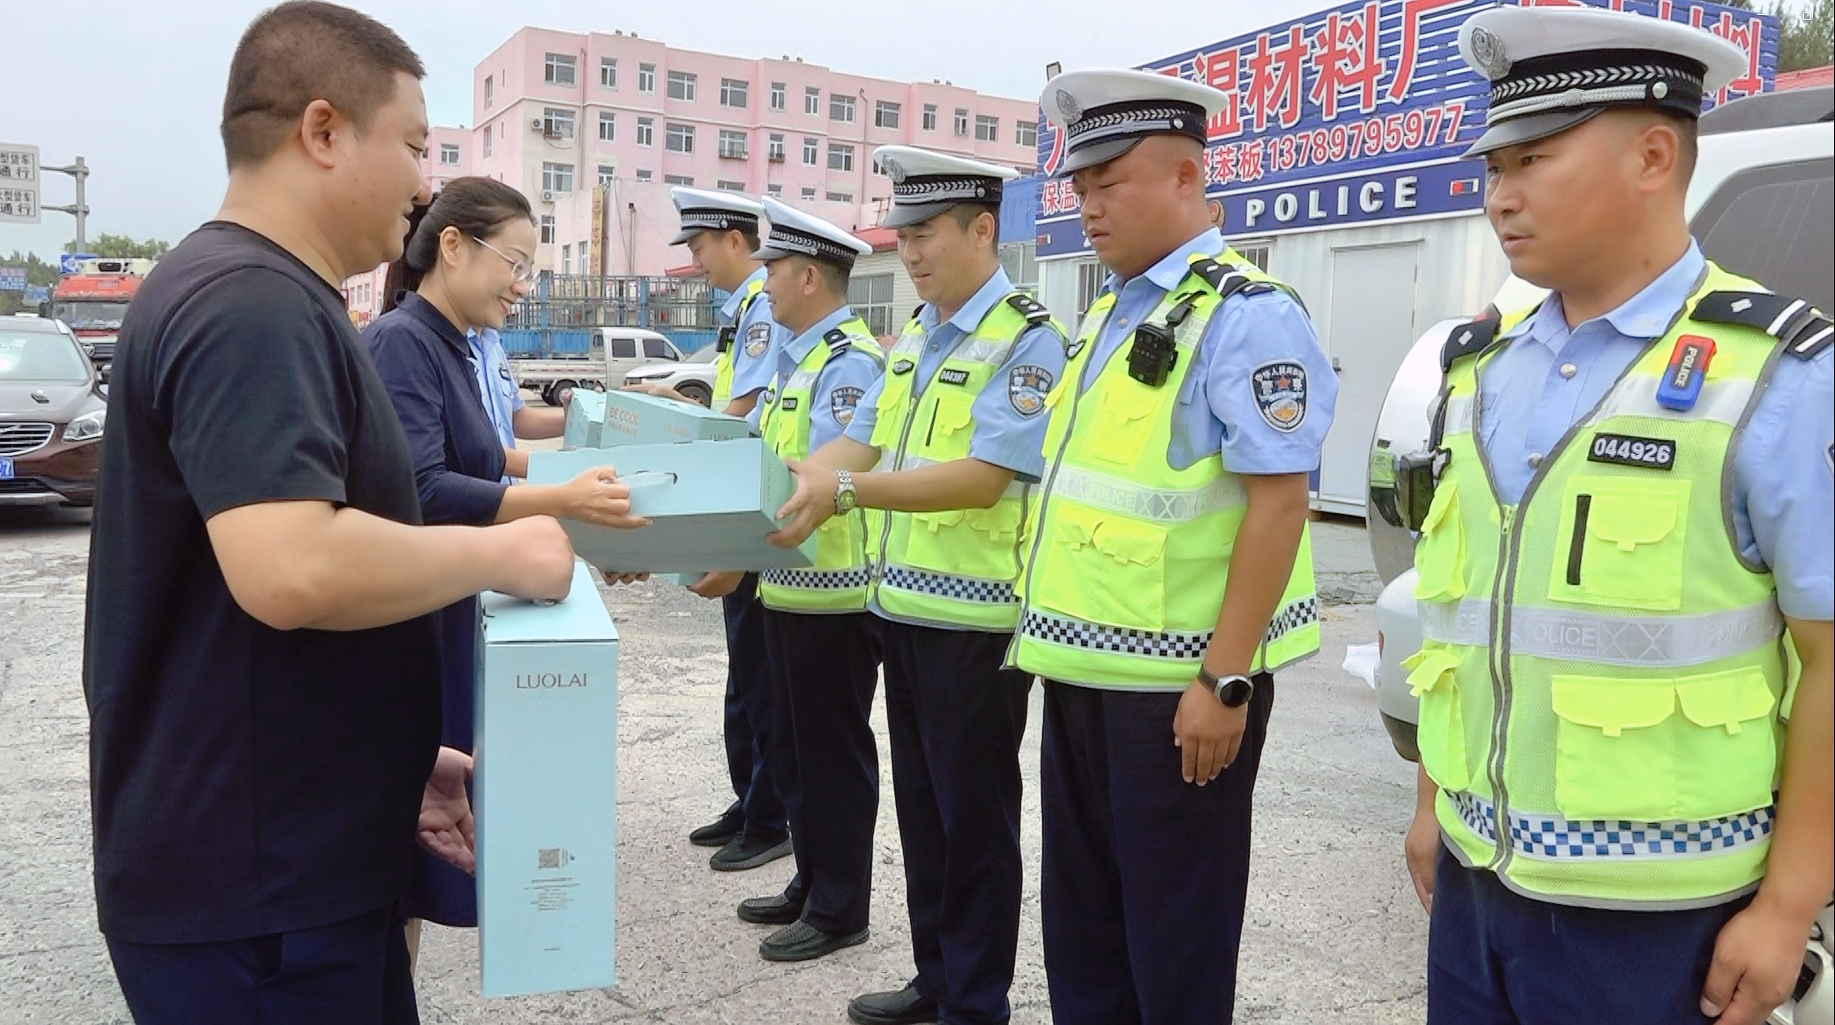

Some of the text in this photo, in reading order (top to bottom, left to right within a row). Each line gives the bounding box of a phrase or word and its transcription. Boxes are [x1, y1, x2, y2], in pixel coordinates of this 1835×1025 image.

[1267, 104, 1466, 172] 13789795977
[1246, 176, 1418, 227] POLICE
[1674, 345, 1698, 387] POLICE
[1593, 437, 1671, 464] 044926
[516, 673, 588, 689] LUOLAI
